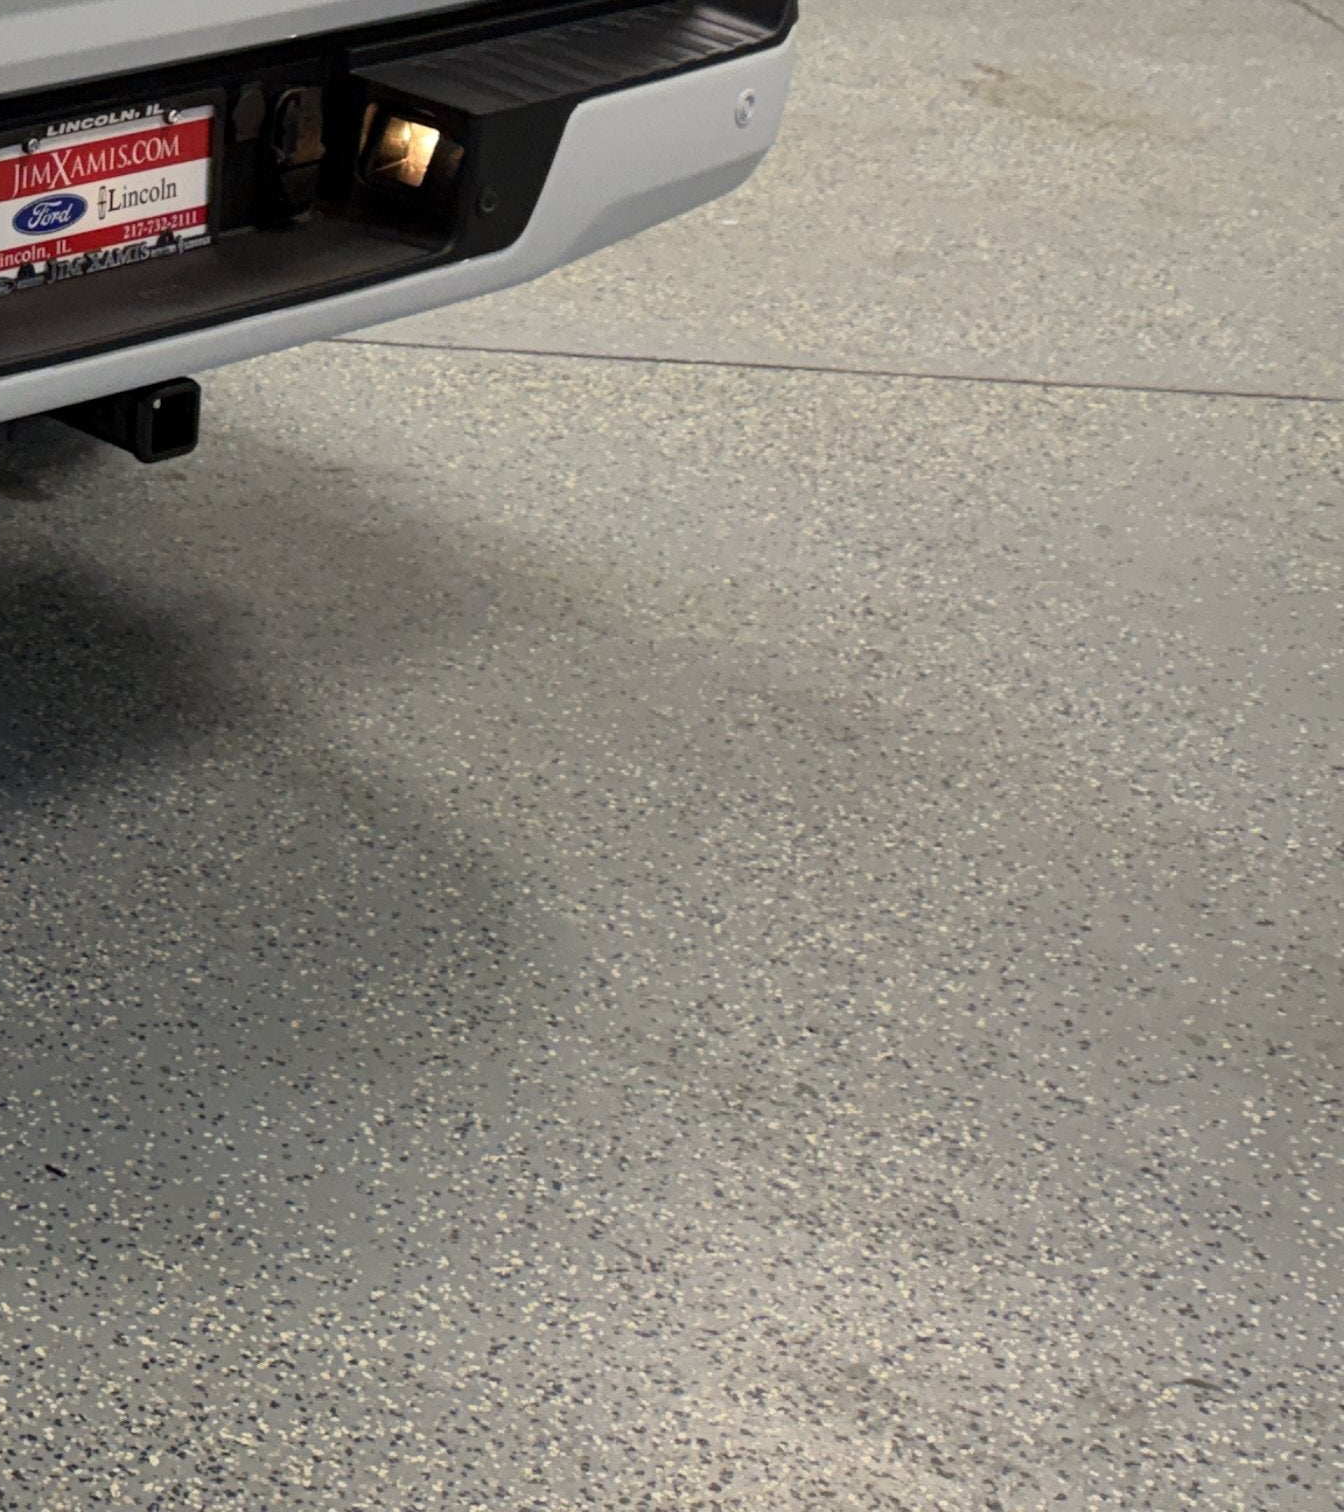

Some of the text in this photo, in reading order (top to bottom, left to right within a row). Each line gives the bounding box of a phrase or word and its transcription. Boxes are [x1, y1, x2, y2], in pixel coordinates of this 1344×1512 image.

[46, 103, 165, 137] LINCOLN, IL
[13, 135, 180, 198] JIMXAMIS.COM
[108, 177, 177, 212] Lincoln
[27, 201, 73, 229] Ford
[56, 240, 72, 255] IL
